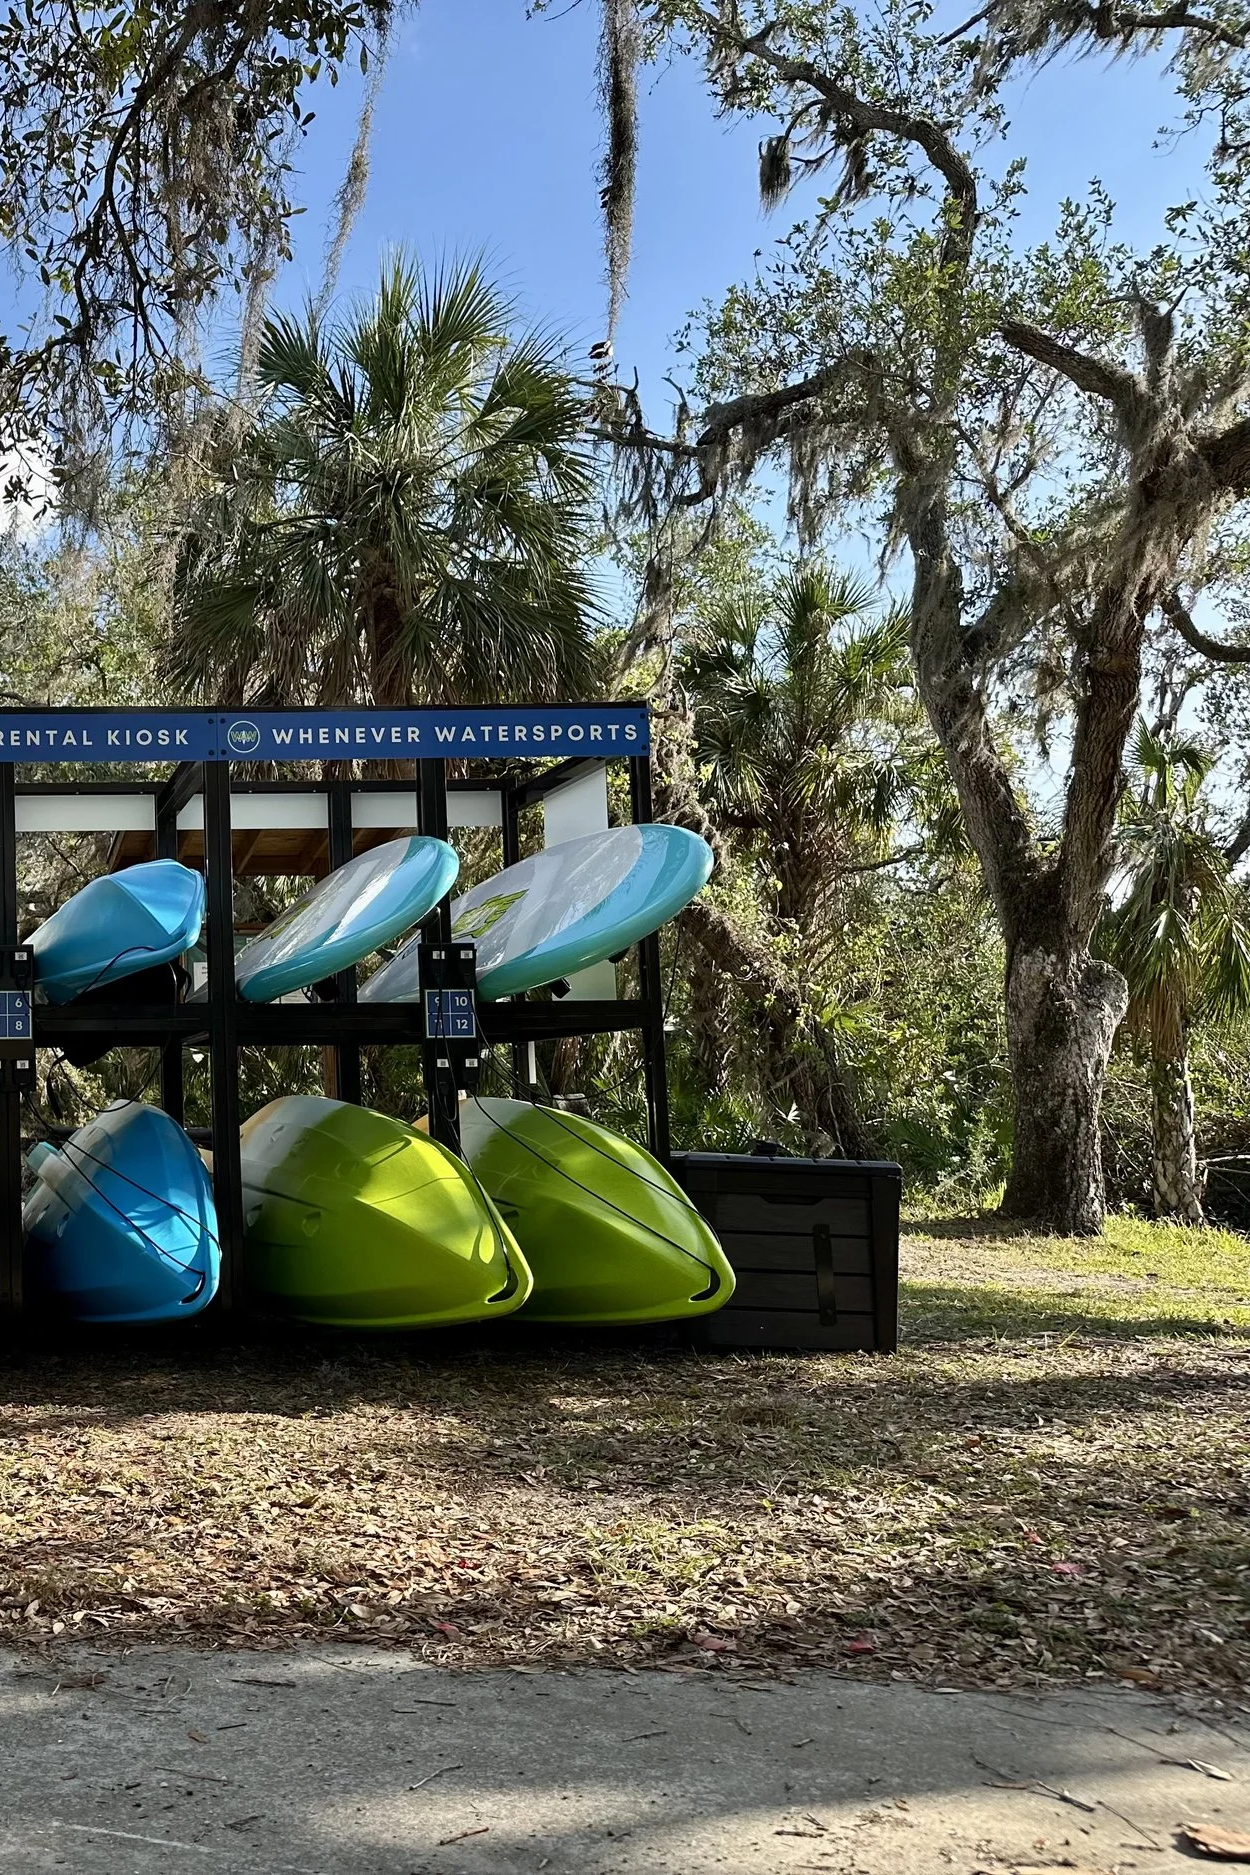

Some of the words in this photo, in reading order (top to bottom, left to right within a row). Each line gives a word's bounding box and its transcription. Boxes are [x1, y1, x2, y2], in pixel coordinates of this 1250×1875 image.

[107, 729, 189, 746] KIOSK
[272, 726, 420, 745] WHENEVER
[434, 724, 637, 742] WATERSPORTS
[15, 997, 23, 1008] 6
[454, 996, 468, 1006] 10
[15, 1020, 23, 1031] 8
[456, 1019, 469, 1029] 12
